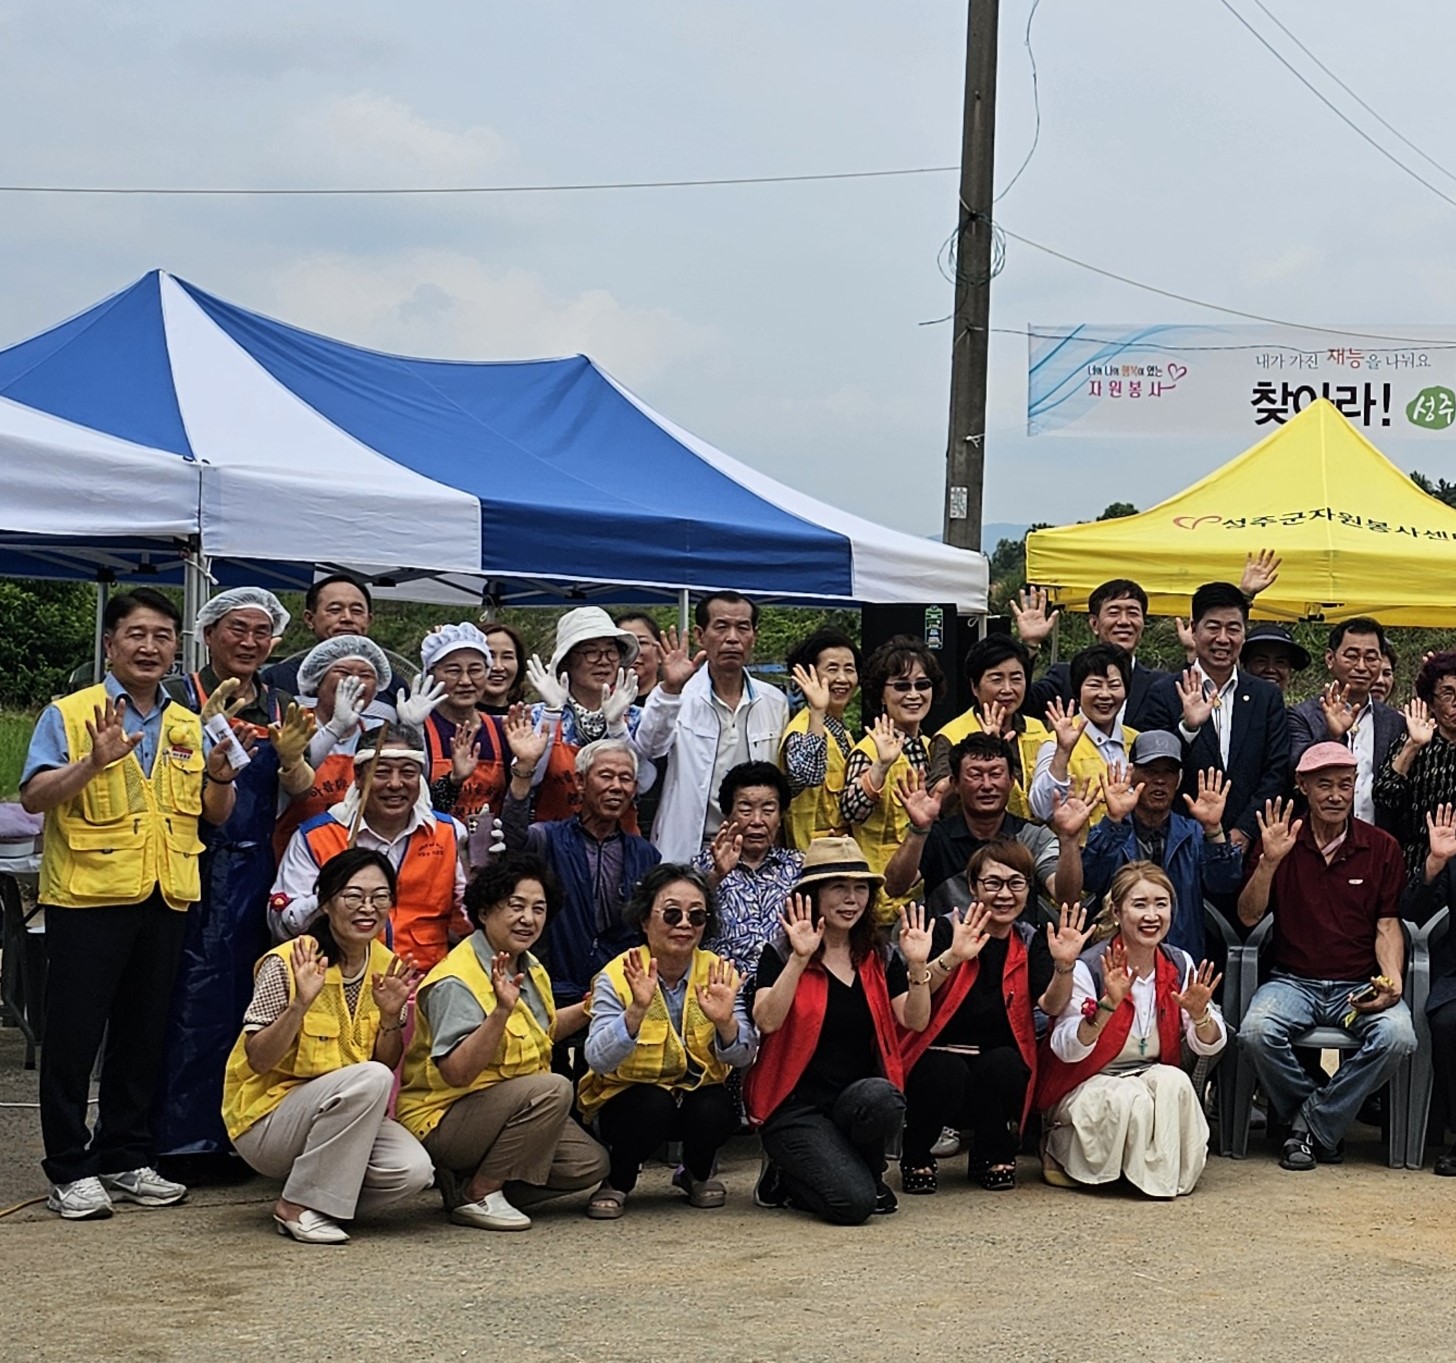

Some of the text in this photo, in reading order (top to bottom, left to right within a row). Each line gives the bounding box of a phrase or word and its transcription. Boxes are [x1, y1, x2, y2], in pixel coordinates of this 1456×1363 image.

[1256, 347, 1431, 369] 내가 가진 재능을 나눠요
[1088, 380, 1176, 398] 자원봉사
[1250, 381, 1391, 427] 찾아라!
[1413, 393, 1455, 424] 성주
